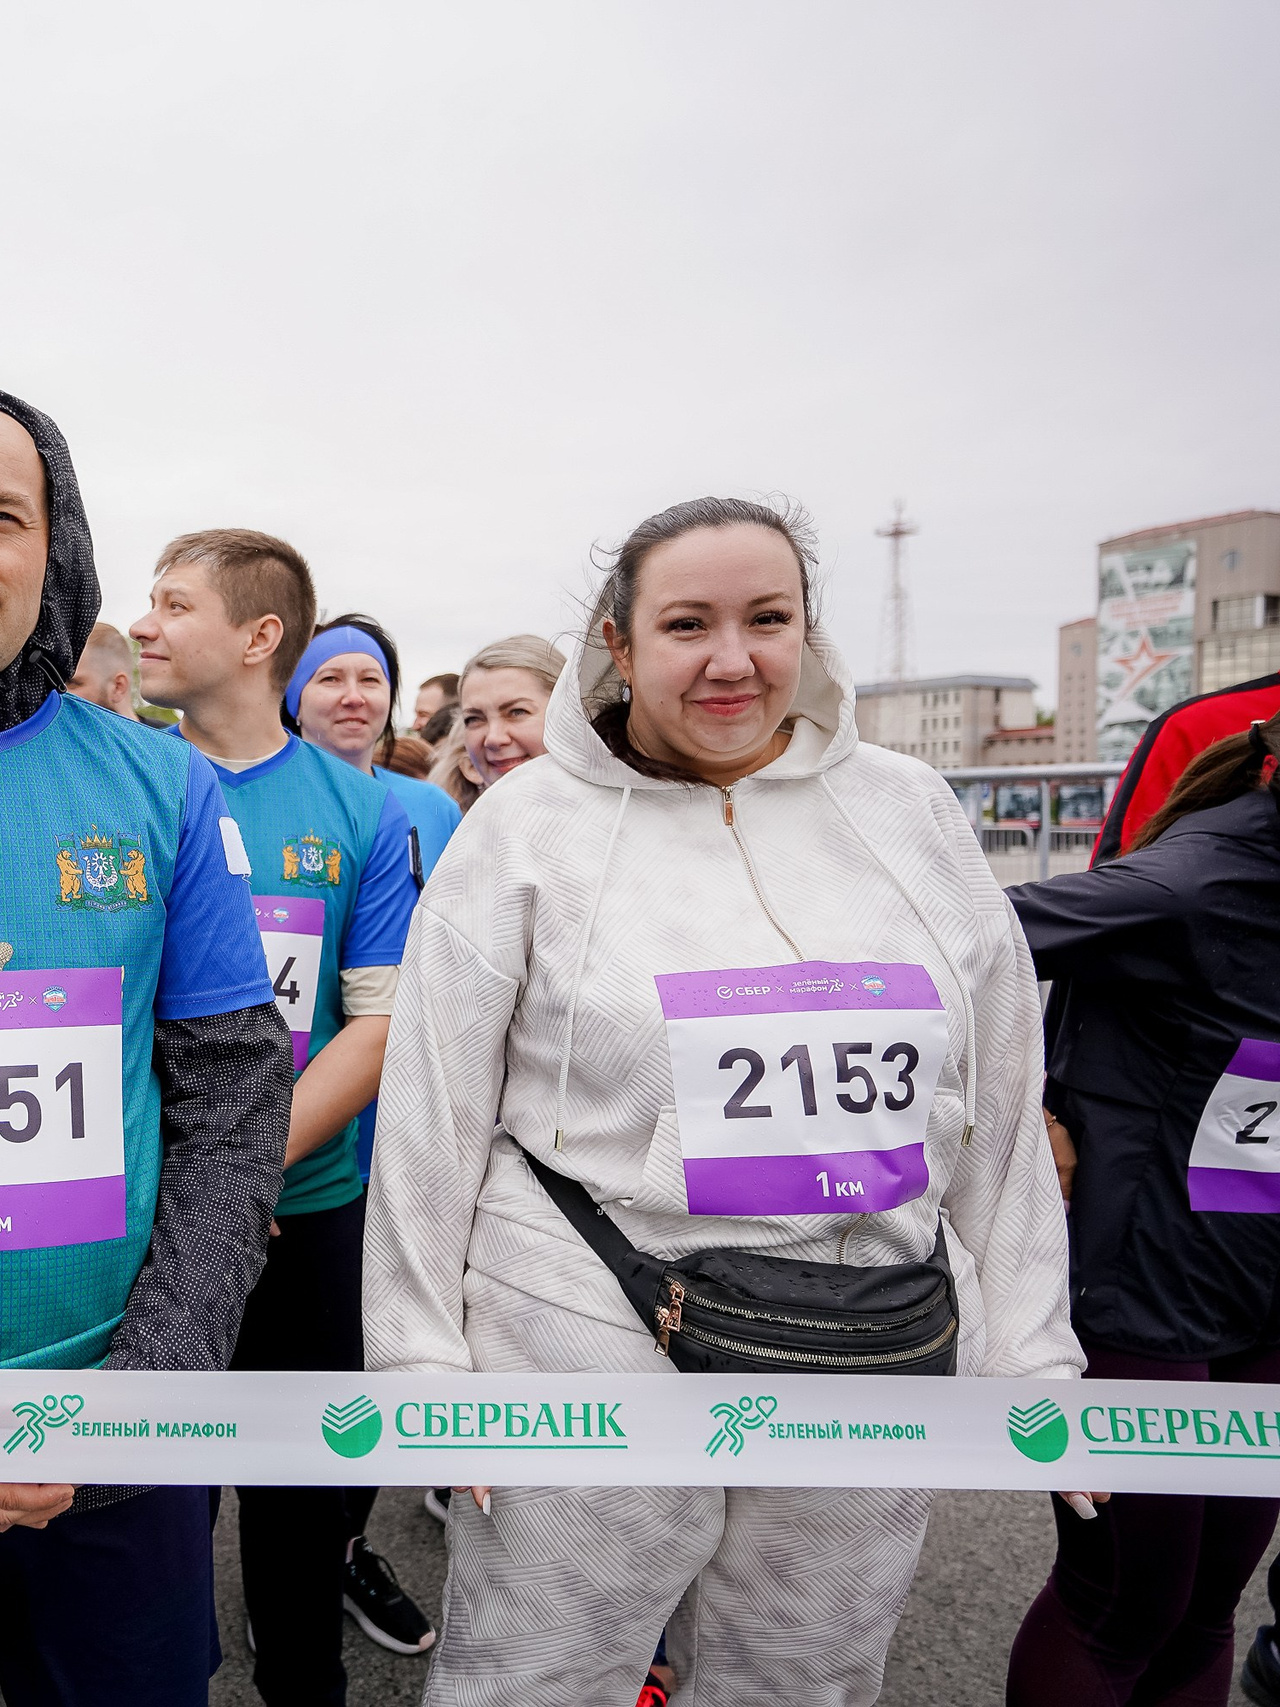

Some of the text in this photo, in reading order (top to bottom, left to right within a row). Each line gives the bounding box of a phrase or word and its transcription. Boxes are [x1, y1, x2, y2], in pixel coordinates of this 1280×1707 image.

[273, 957, 300, 1004] 4
[735, 986, 771, 996] СБЕР
[789, 985, 828, 994] марафон
[793, 977, 830, 986] зелёный
[718, 1042, 920, 1119] 2153
[1235, 1101, 1277, 1144] 2
[71, 1418, 237, 1438] ЗЕЛЕНЫЙ МАРАФОН
[394, 1402, 627, 1438] СБЕРБАНК
[767, 1418, 926, 1441] ЗЕЛЕНЫЙ МАРАФОН
[1080, 1405, 1280, 1447] СБЕРБАН
